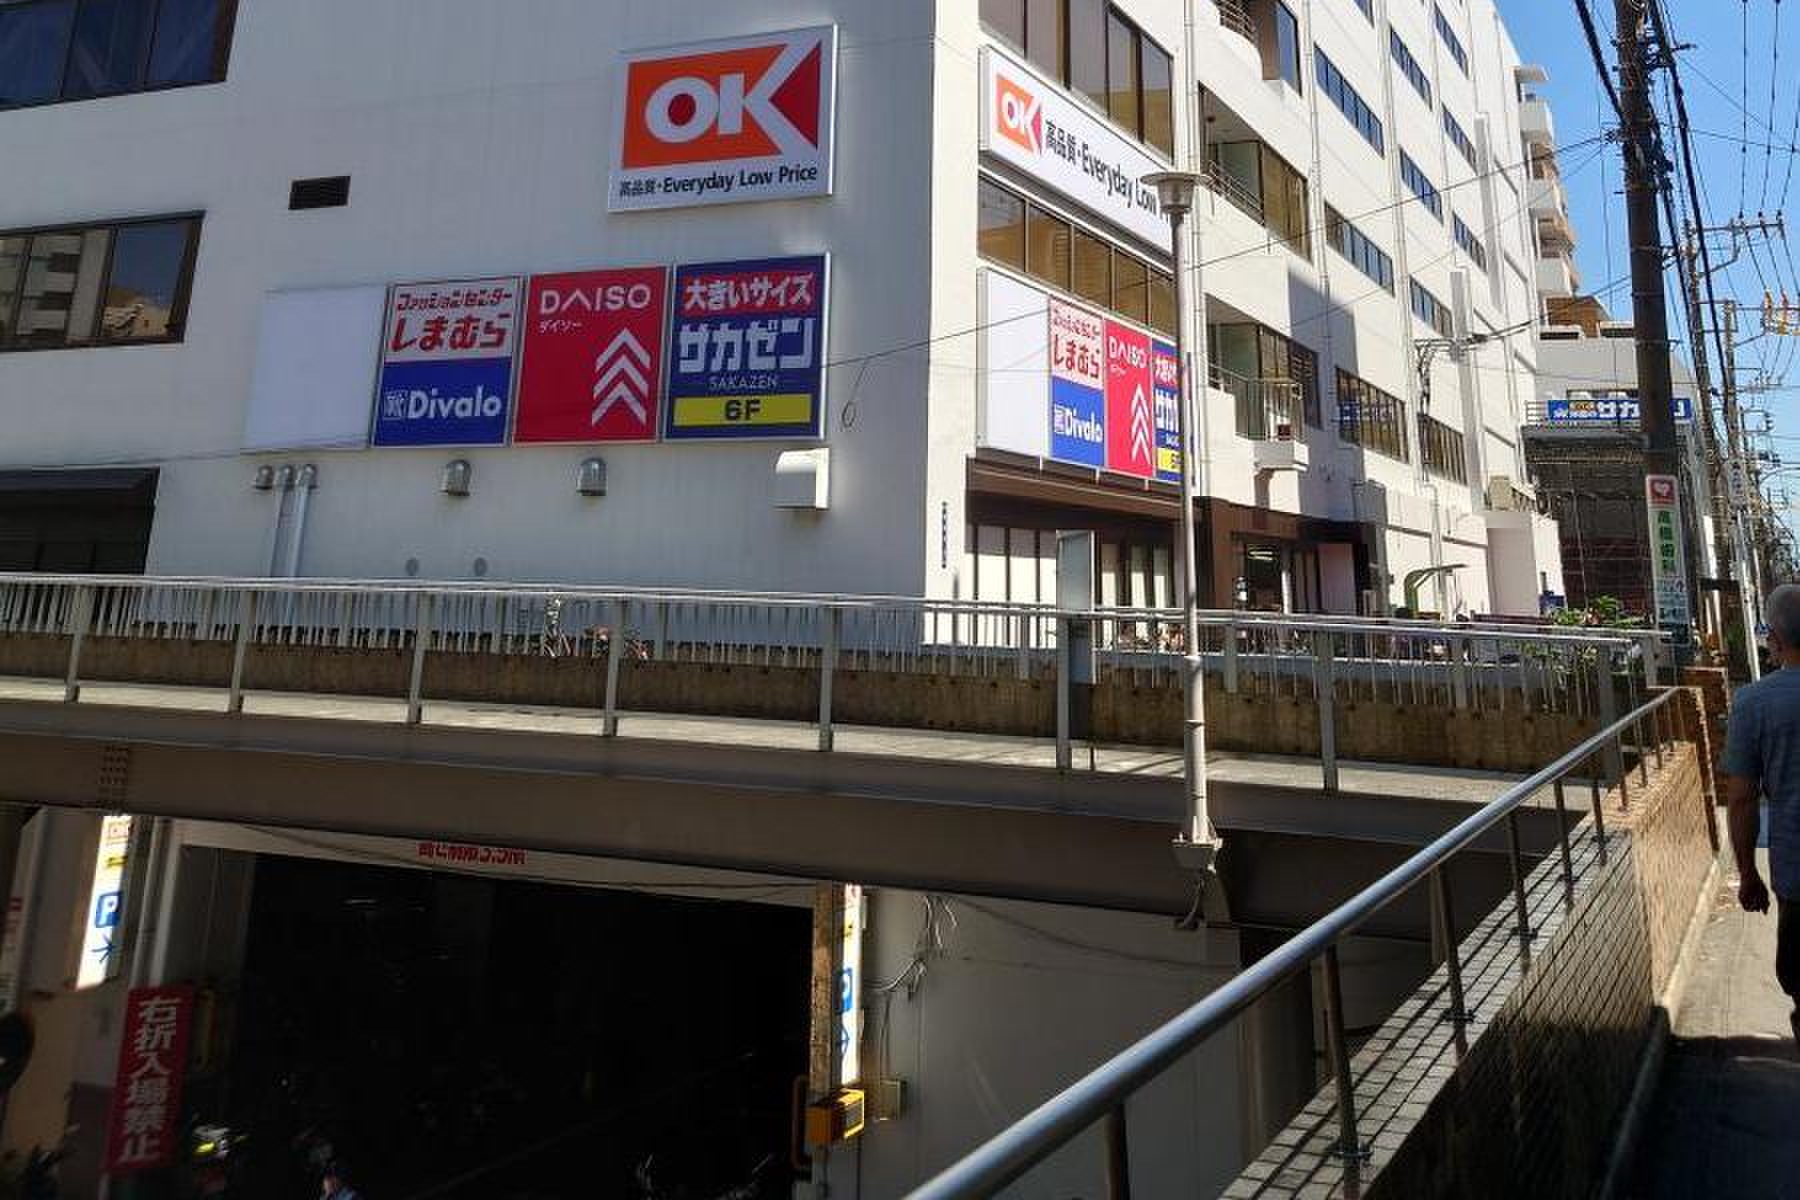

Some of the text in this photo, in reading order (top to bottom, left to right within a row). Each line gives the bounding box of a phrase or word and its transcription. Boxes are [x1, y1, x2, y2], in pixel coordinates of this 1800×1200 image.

[645, 40, 819, 152] OK
[1001, 90, 1042, 154] OK
[739, 169, 773, 187] Low
[778, 163, 818, 184] Price
[540, 284, 651, 316] DAISO
[684, 273, 813, 311] 大きいサイズ
[389, 313, 511, 352] しまむら
[679, 317, 816, 373] サカゼン
[1055, 334, 1100, 379] しまむら
[1108, 335, 1147, 369] DAISO
[407, 385, 502, 419] Divalo
[725, 399, 762, 421] 6F
